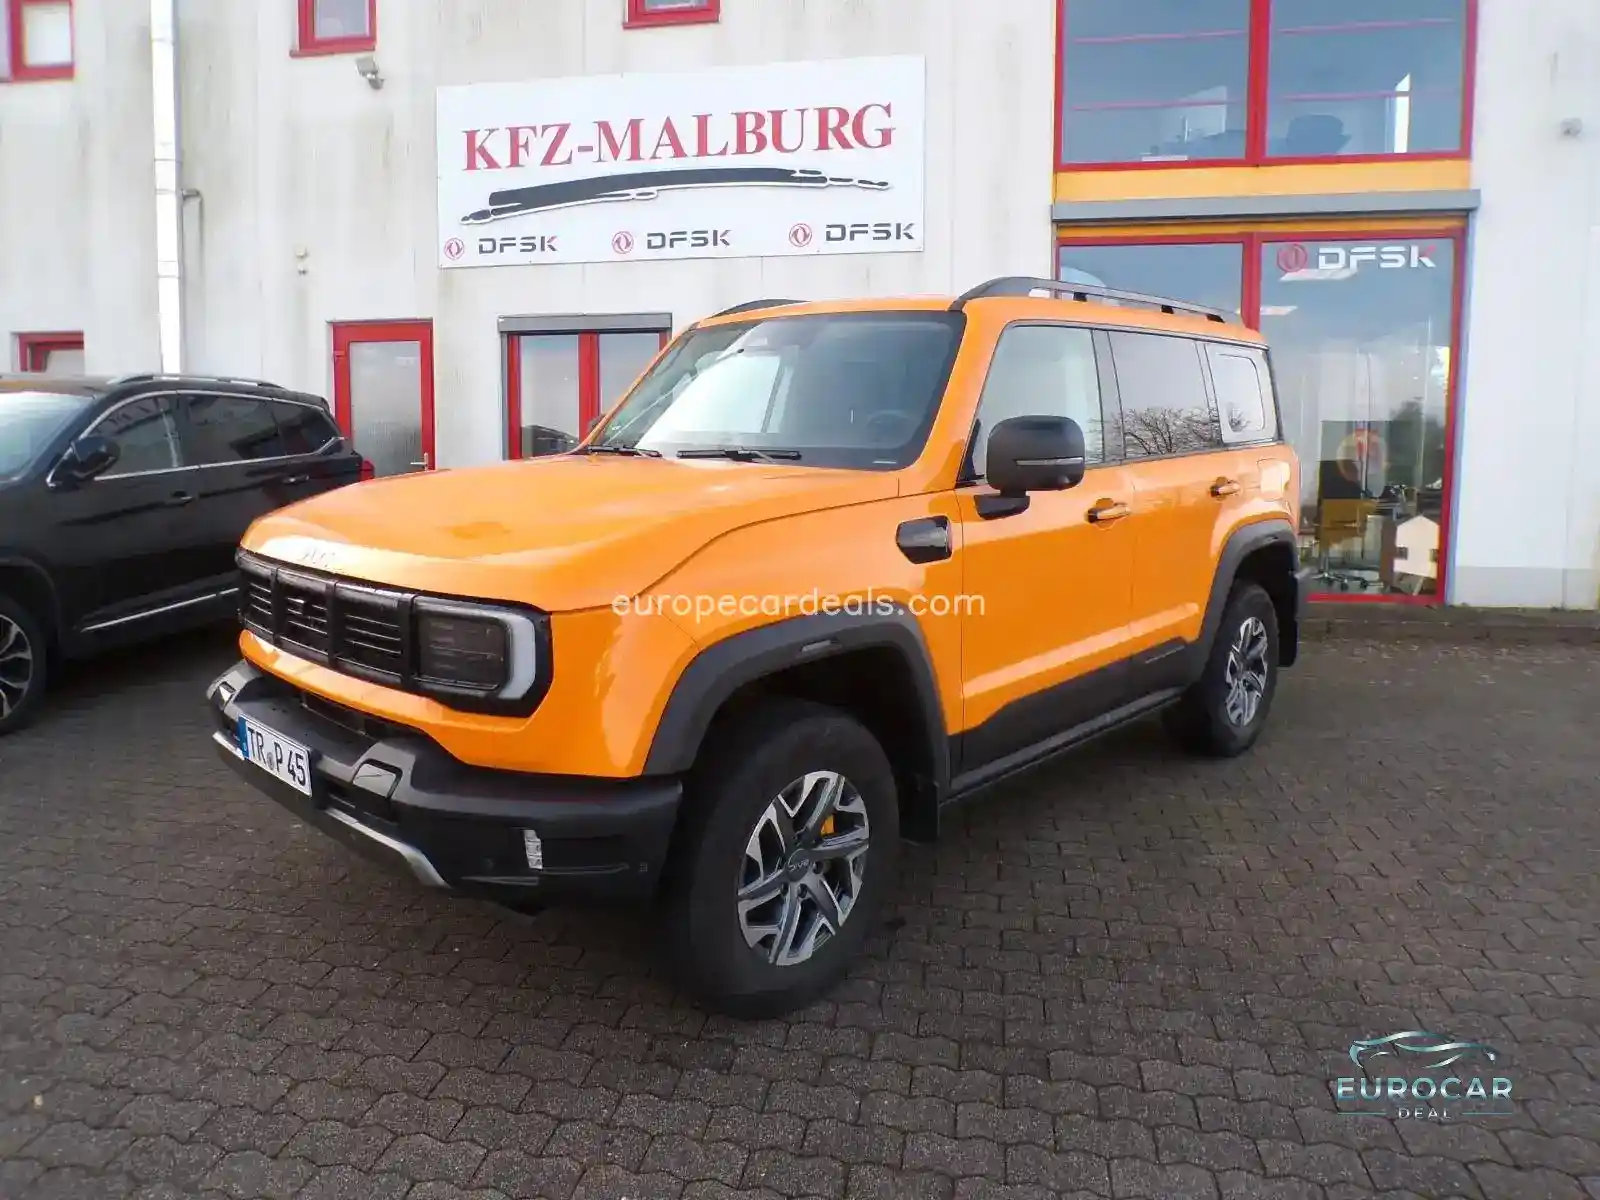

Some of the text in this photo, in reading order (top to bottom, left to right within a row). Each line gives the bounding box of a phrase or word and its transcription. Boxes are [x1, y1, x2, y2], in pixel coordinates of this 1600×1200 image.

[462, 102, 896, 170] KFZ-MALBURG
[646, 229, 732, 250] DFSK
[825, 222, 915, 242] DFSK
[478, 235, 559, 255] DFSK
[1318, 244, 1437, 270] DFSK
[248, 727, 306, 786] TR P 45
